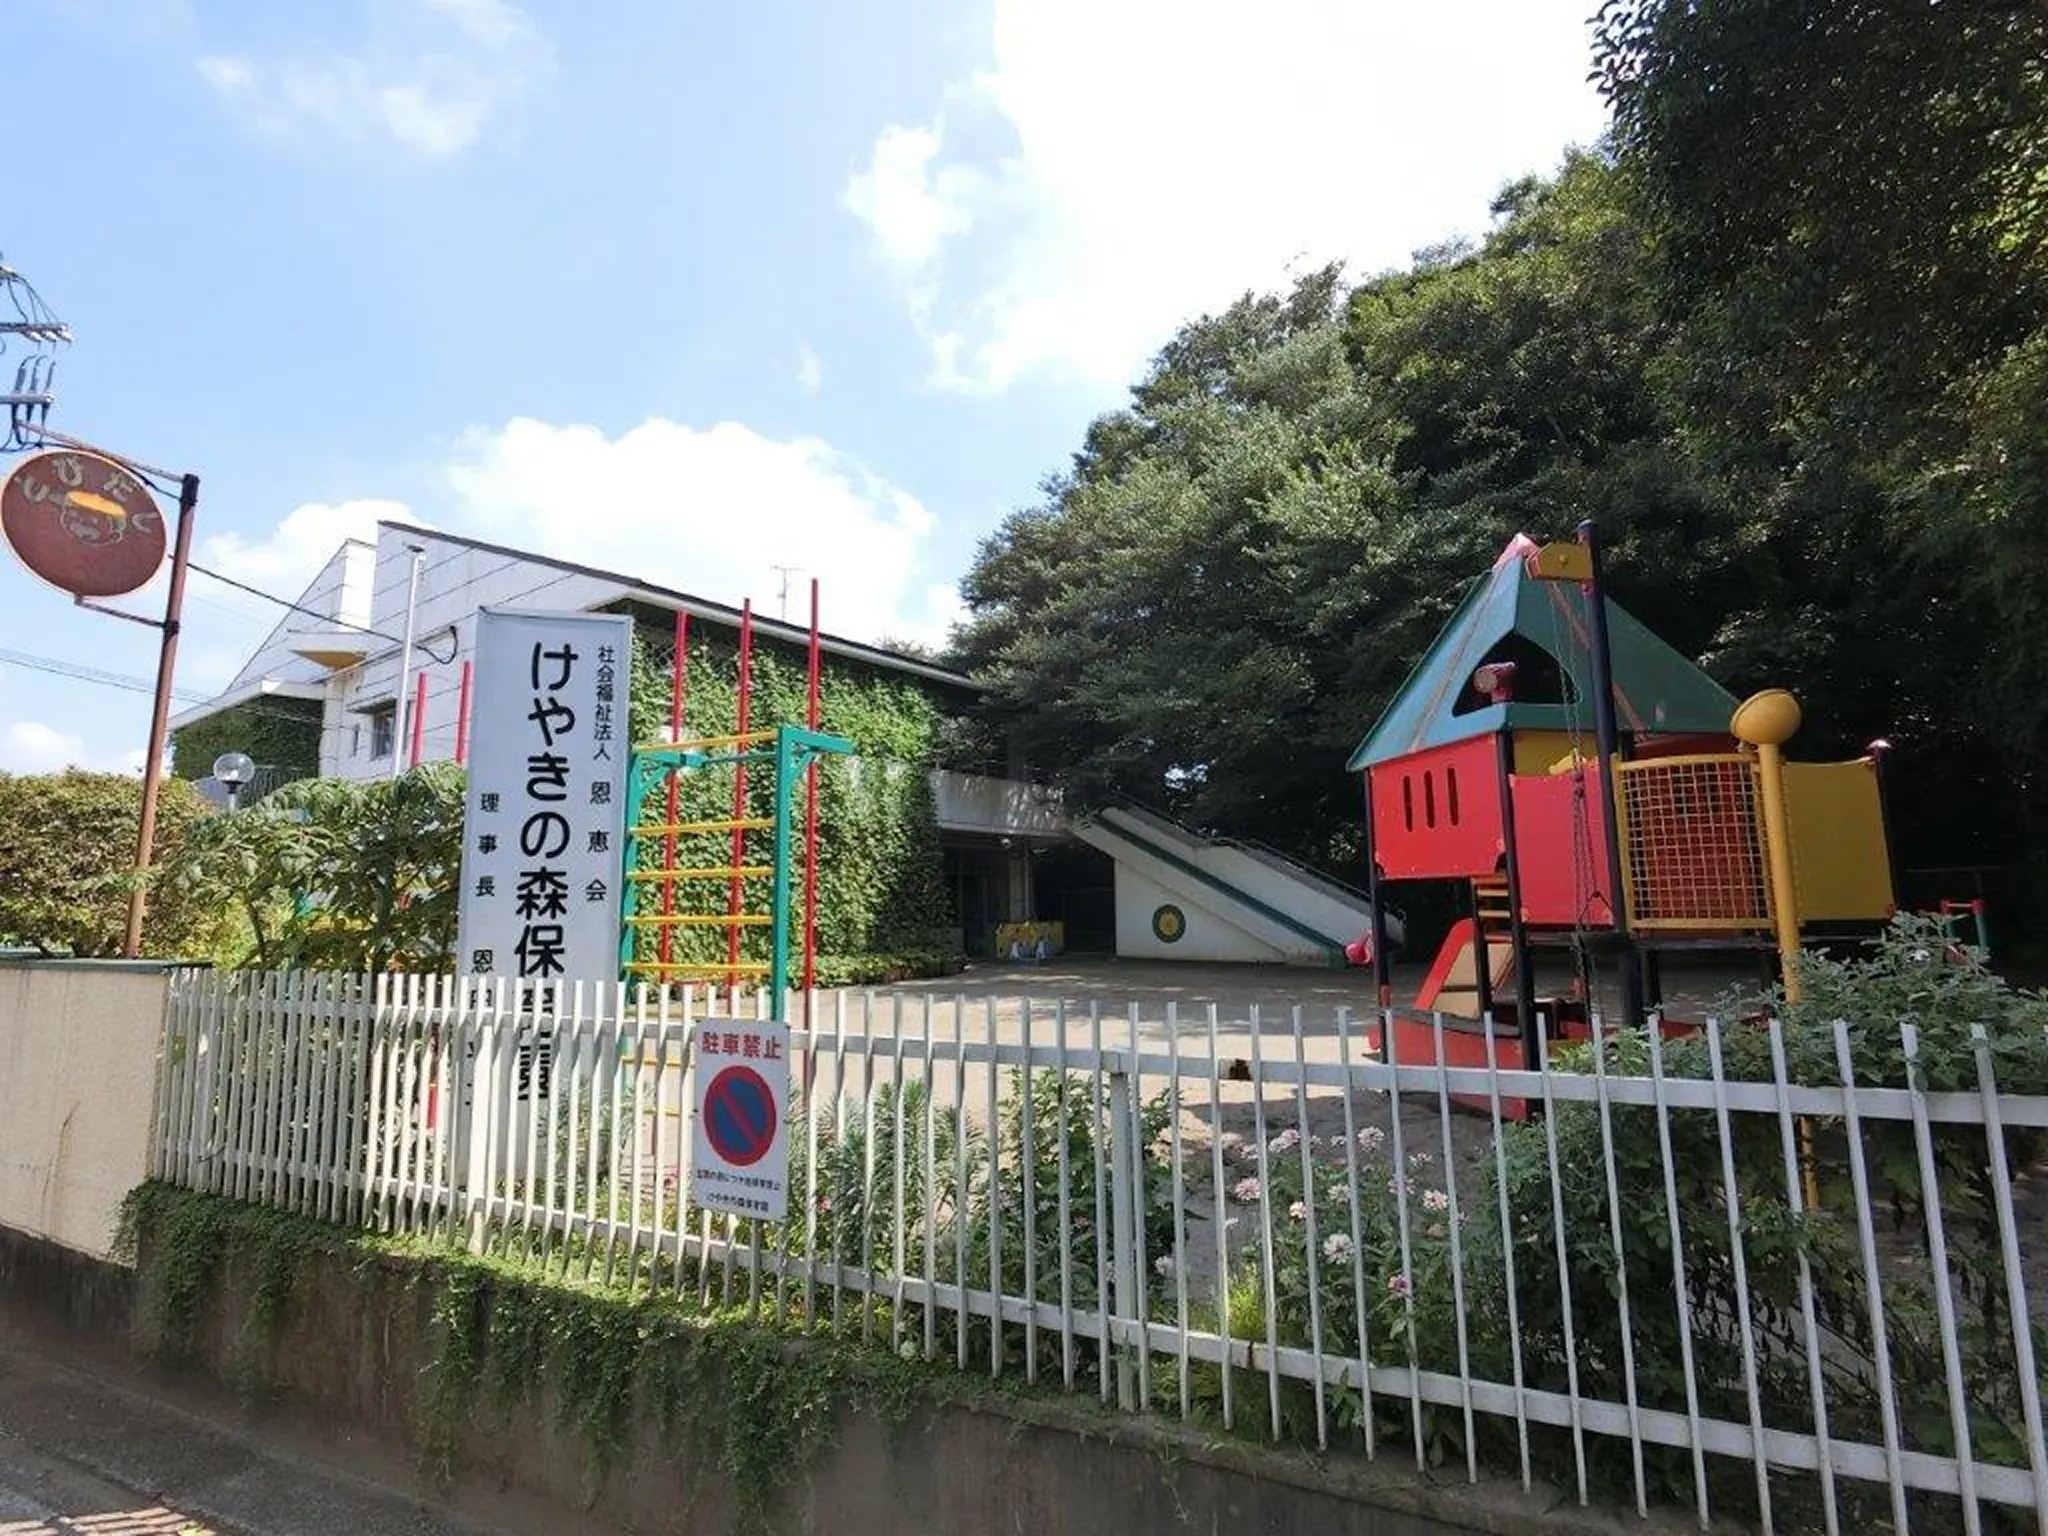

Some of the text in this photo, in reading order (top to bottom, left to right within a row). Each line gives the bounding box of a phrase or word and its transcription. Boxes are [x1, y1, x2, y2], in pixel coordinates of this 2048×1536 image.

[585, 645, 616, 902] 社会福祉法人 恩恵会
[475, 792, 500, 897] 理事長
[701, 1031, 782, 1060] 駐車禁止
